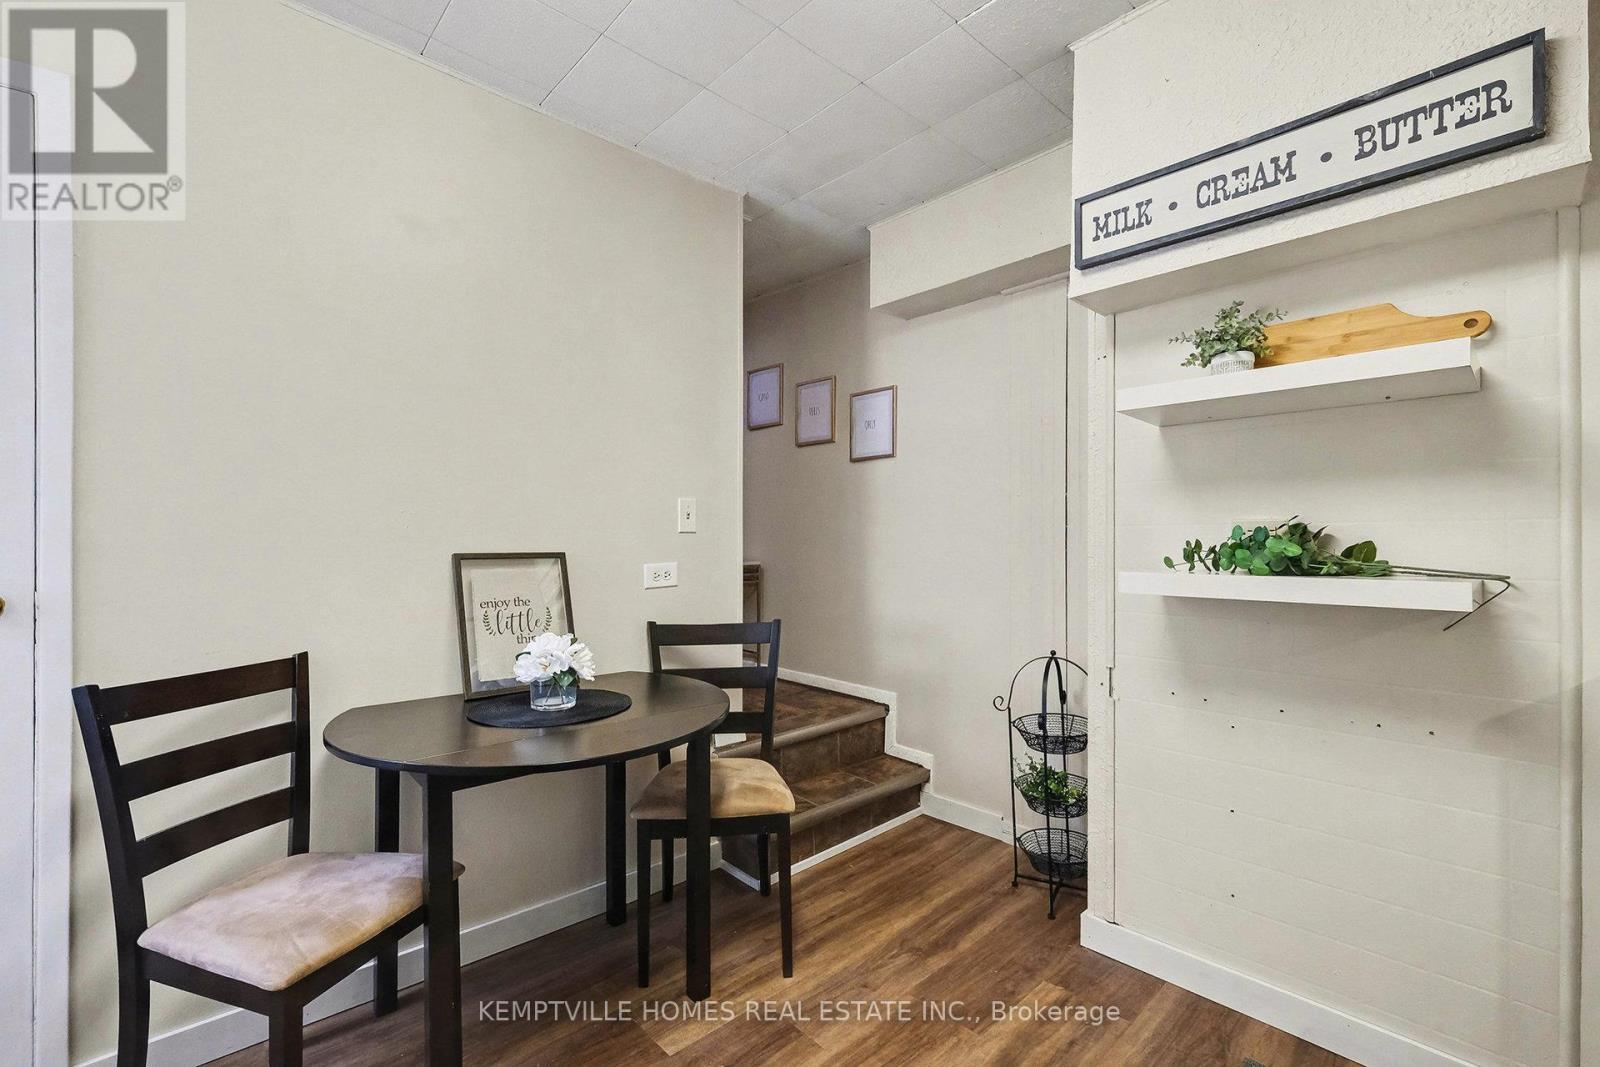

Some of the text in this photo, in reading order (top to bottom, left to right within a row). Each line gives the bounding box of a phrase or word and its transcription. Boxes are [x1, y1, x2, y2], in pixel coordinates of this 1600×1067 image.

[1092, 79, 1513, 242] MILK CREAM BUTTER
[480, 597, 531, 610] enjoy the
[496, 608, 542, 635] little
